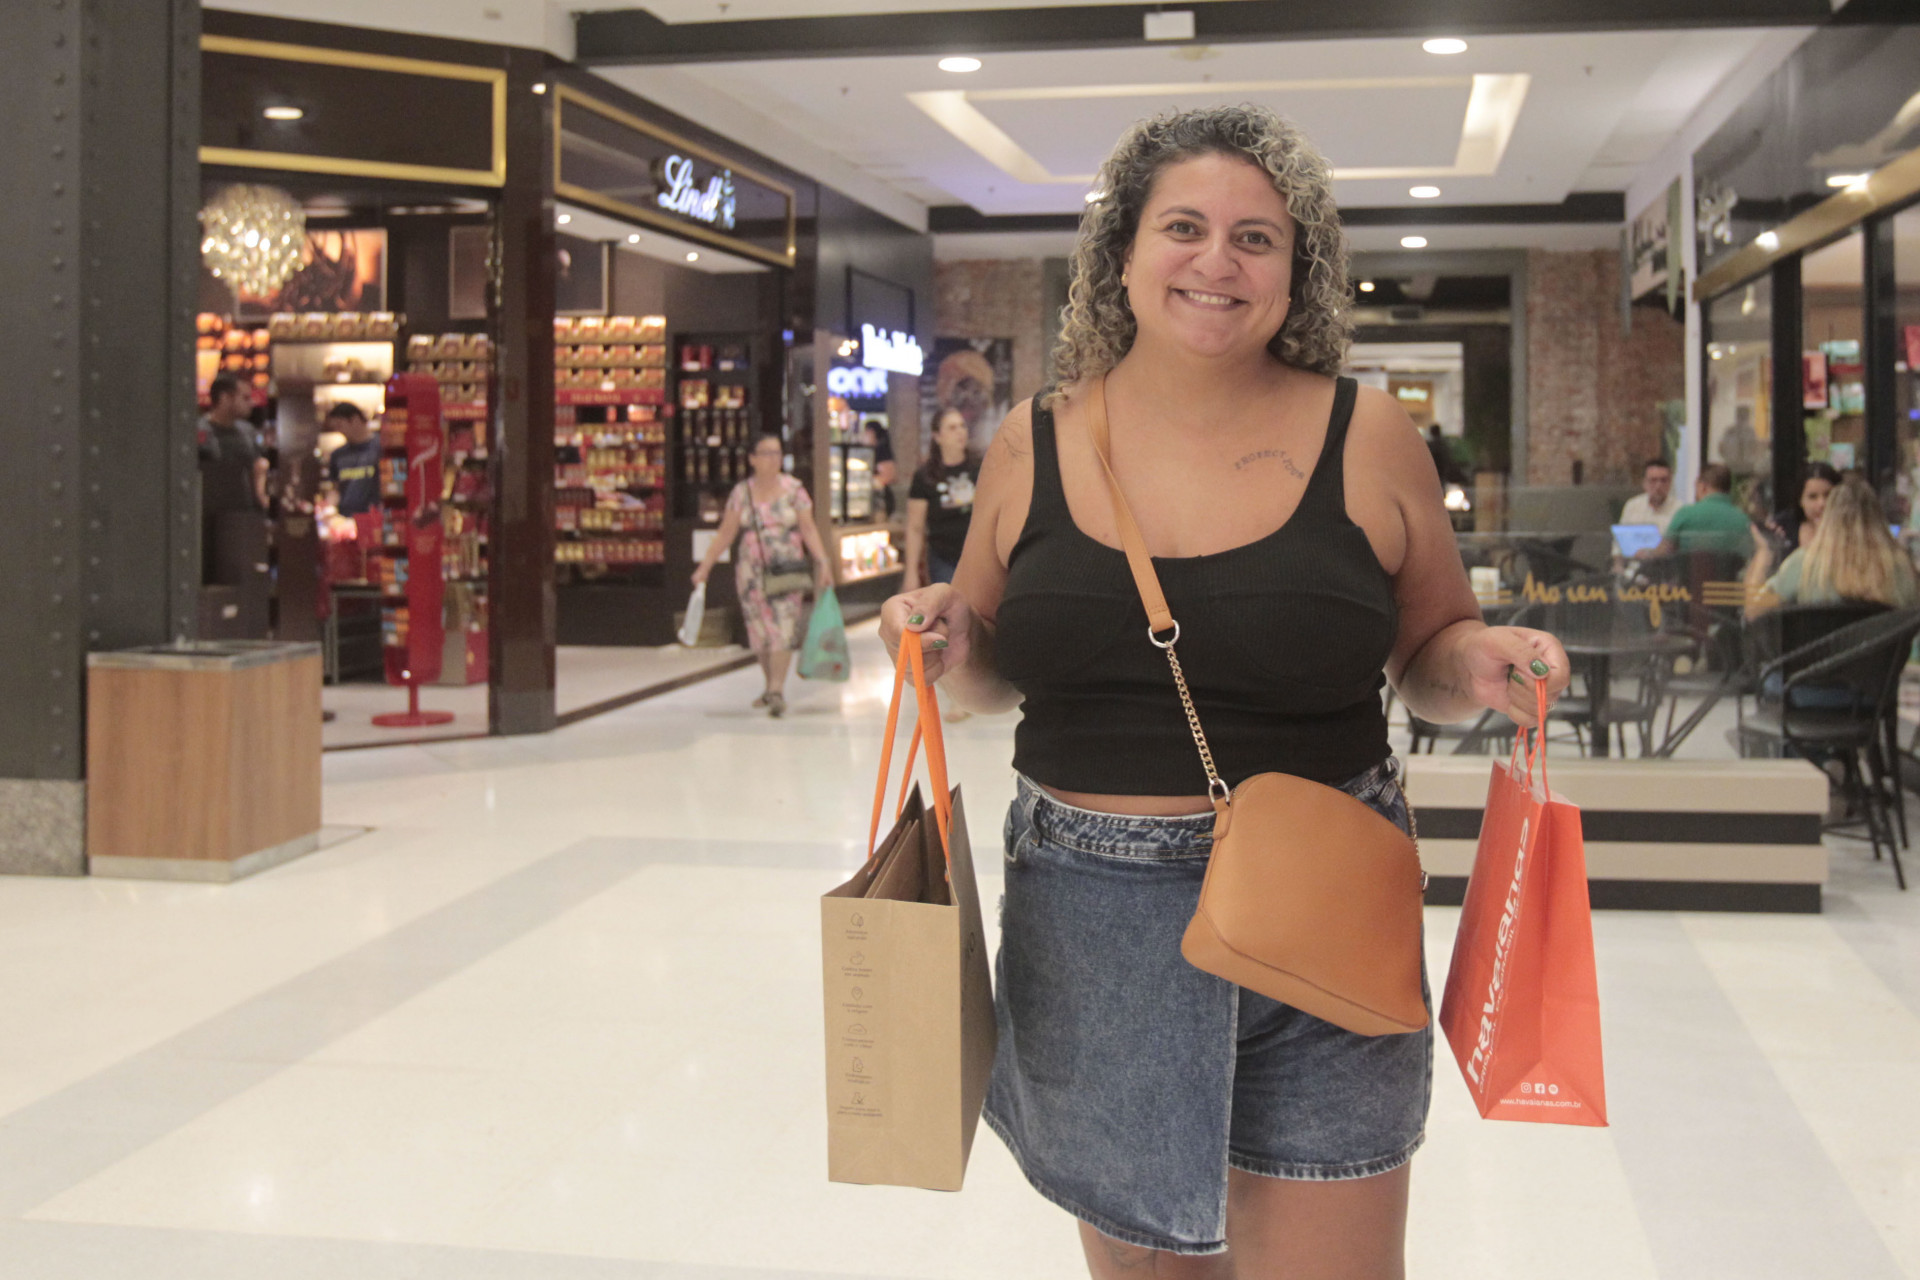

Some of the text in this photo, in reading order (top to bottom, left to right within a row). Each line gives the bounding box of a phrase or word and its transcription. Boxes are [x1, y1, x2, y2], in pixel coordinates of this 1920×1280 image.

[658, 154, 723, 223] Lindt
[1466, 816, 1529, 1084] havaianas
[1499, 1097, 1582, 1109] www.havaianas.com.br
